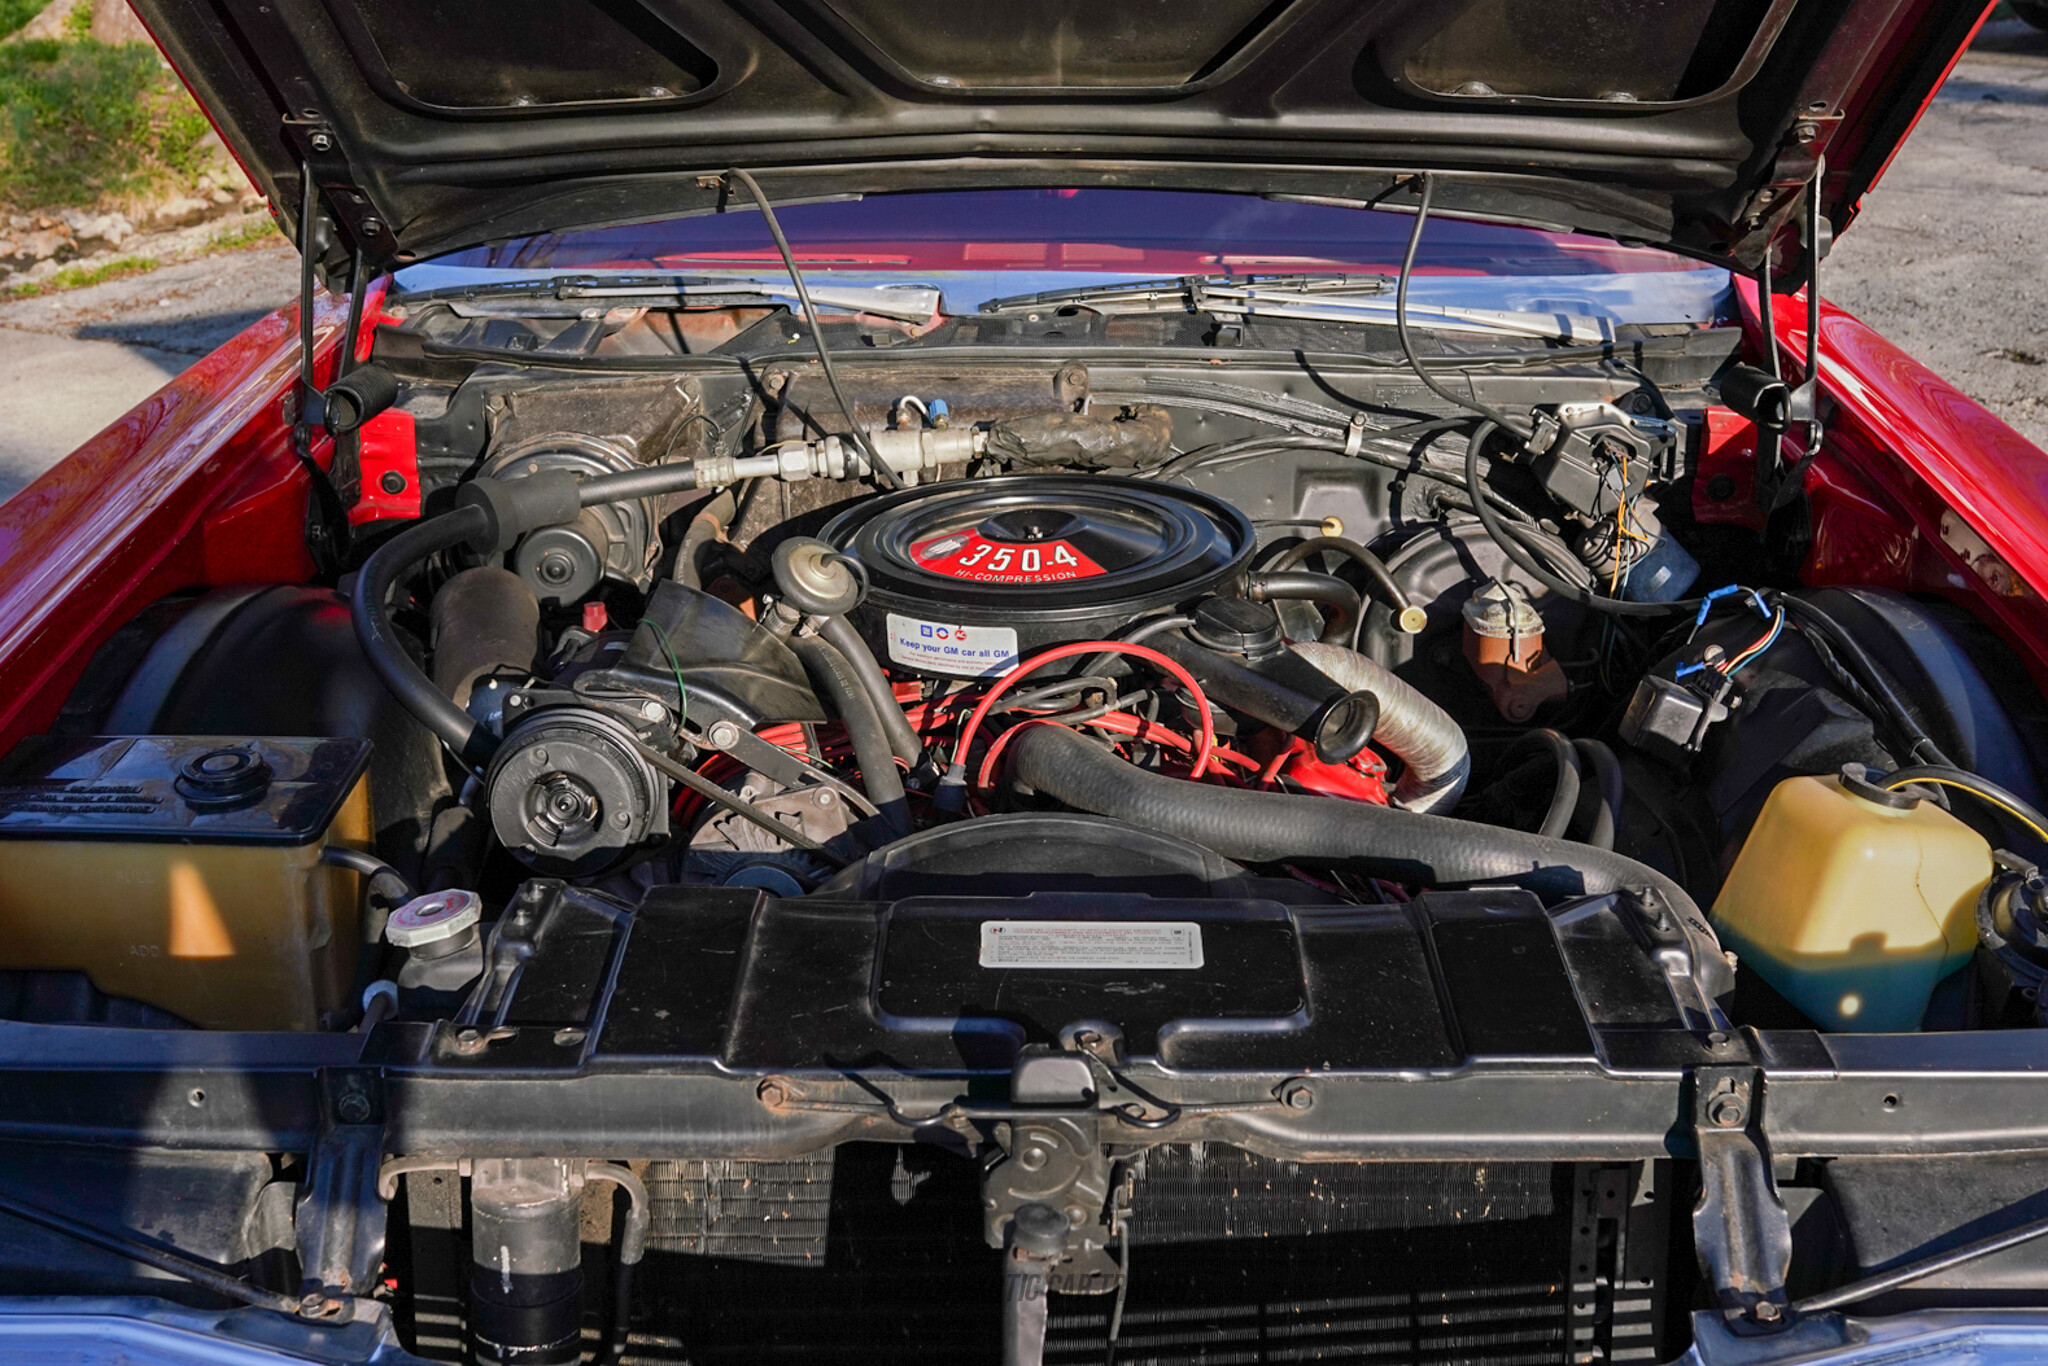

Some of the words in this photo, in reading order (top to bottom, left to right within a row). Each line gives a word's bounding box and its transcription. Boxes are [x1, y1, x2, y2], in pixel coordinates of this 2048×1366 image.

[954, 568, 1077, 583] HI-COMPRESSION
[899, 637, 921, 650] Keep
[922, 644, 941, 654] your
[943, 646, 959, 655] GM
[961, 649, 976, 657] car
[978, 649, 991, 658] all
[993, 650, 1010, 658] GM
